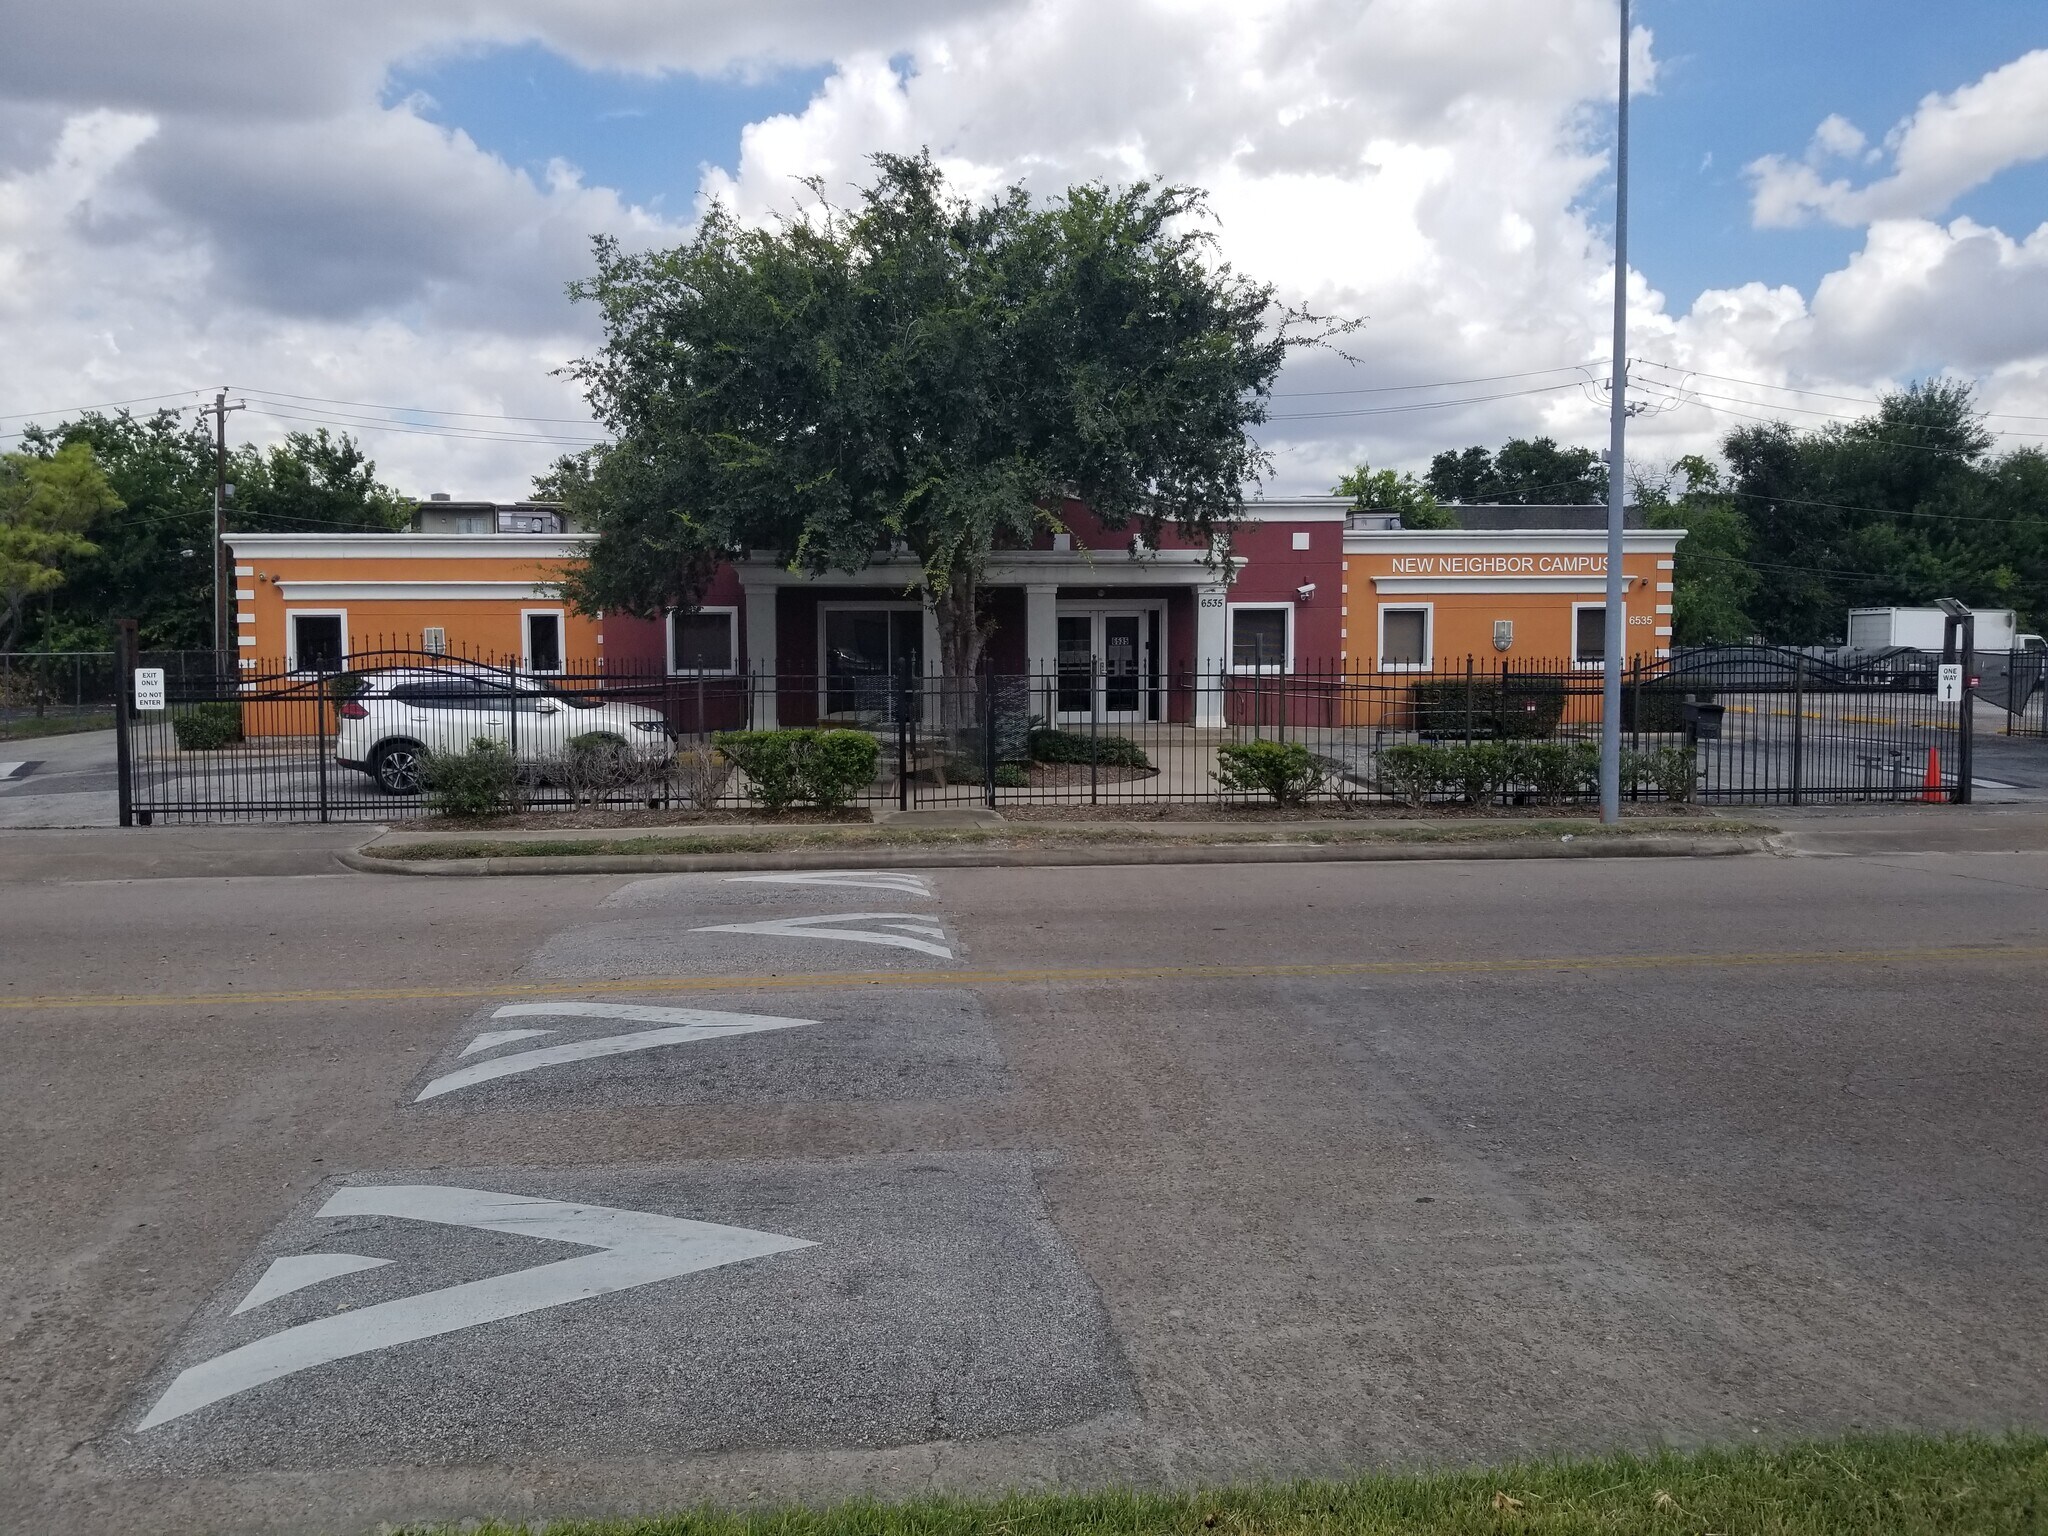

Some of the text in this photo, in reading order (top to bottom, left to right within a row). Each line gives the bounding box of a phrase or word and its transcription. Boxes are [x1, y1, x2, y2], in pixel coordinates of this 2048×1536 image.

[1392, 558, 1434, 573] NEW
[1439, 557, 1533, 573] NEIGHBOR
[1201, 598, 1223, 608] 6535
[1628, 615, 1653, 625] 6535
